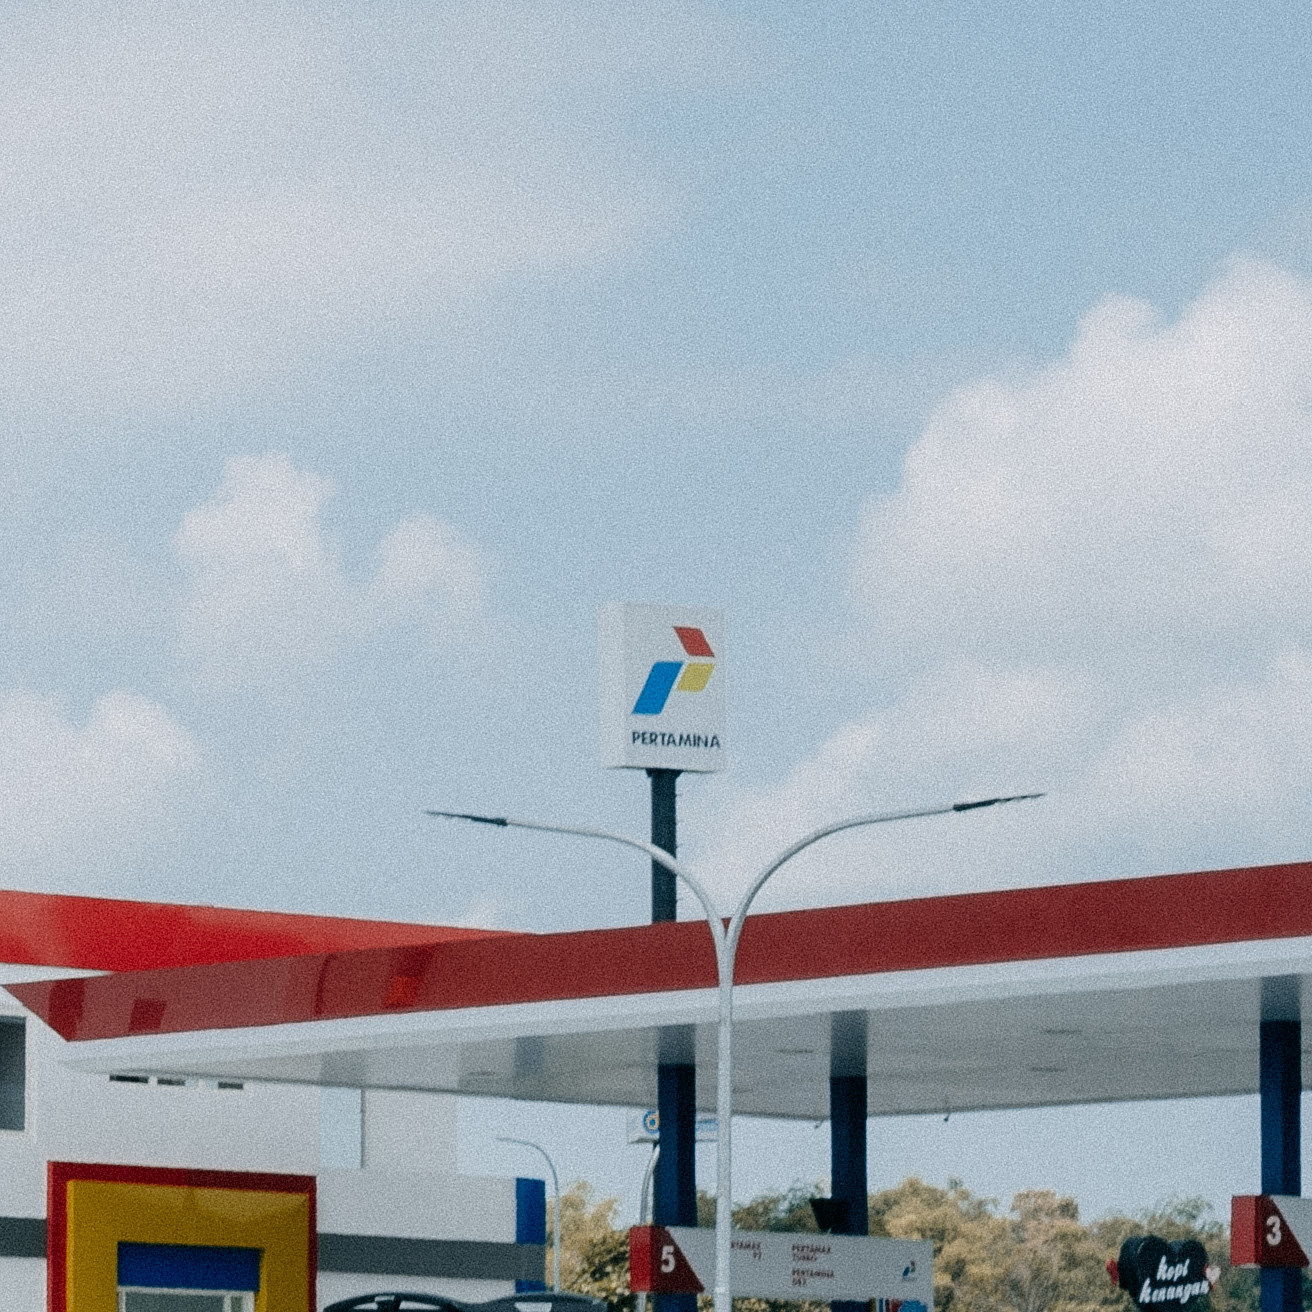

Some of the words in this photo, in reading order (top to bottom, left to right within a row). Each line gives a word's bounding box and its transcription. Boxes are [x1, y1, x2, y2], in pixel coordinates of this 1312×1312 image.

[631, 731, 721, 748] PERTAMINA
[1266, 1215, 1282, 1246] 3
[660, 1246, 676, 1273] 5
[1156, 1255, 1190, 1282] kopi
